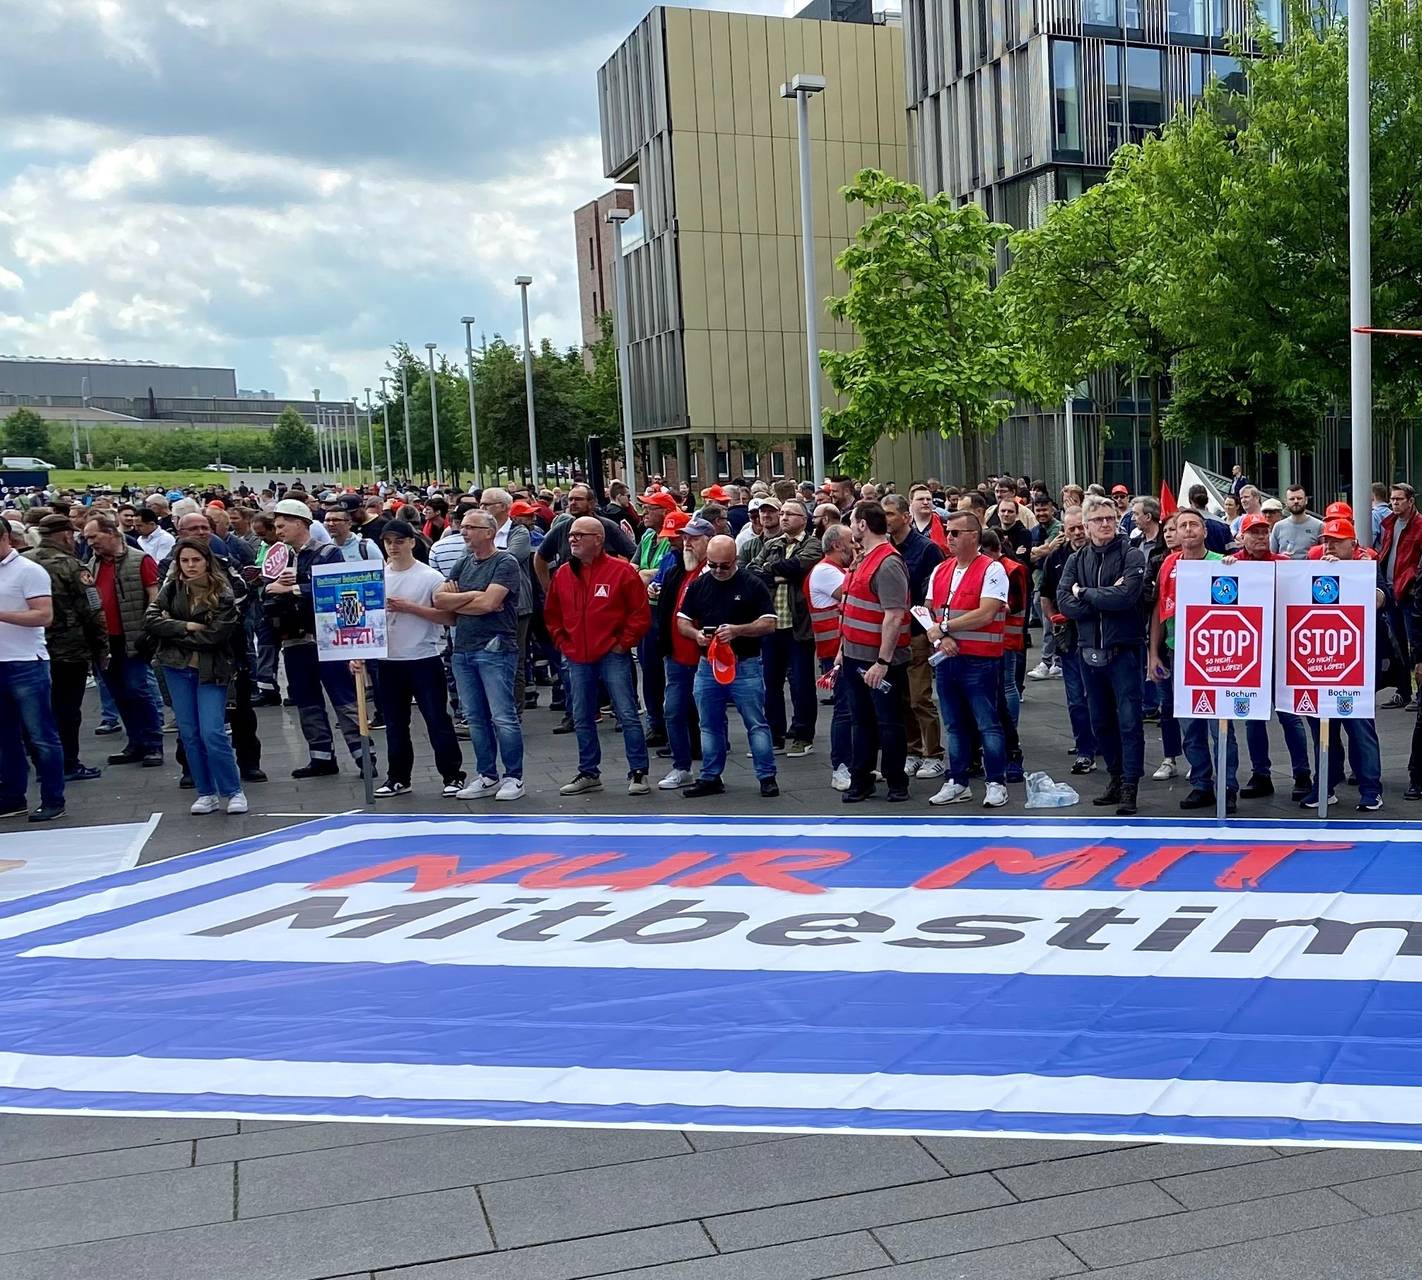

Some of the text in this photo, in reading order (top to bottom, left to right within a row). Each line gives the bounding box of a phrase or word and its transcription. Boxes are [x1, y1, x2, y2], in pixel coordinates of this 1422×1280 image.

[265, 548, 284, 570] STOP
[332, 628, 375, 646] JETZT!
[1197, 629, 1251, 656] STOP
[1298, 628, 1353, 656] STOP
[1205, 665, 1221, 673] HERR
[1225, 690, 1257, 698] Bochum
[1328, 689, 1361, 697] Bochum
[306, 841, 1359, 895] NUR MIT
